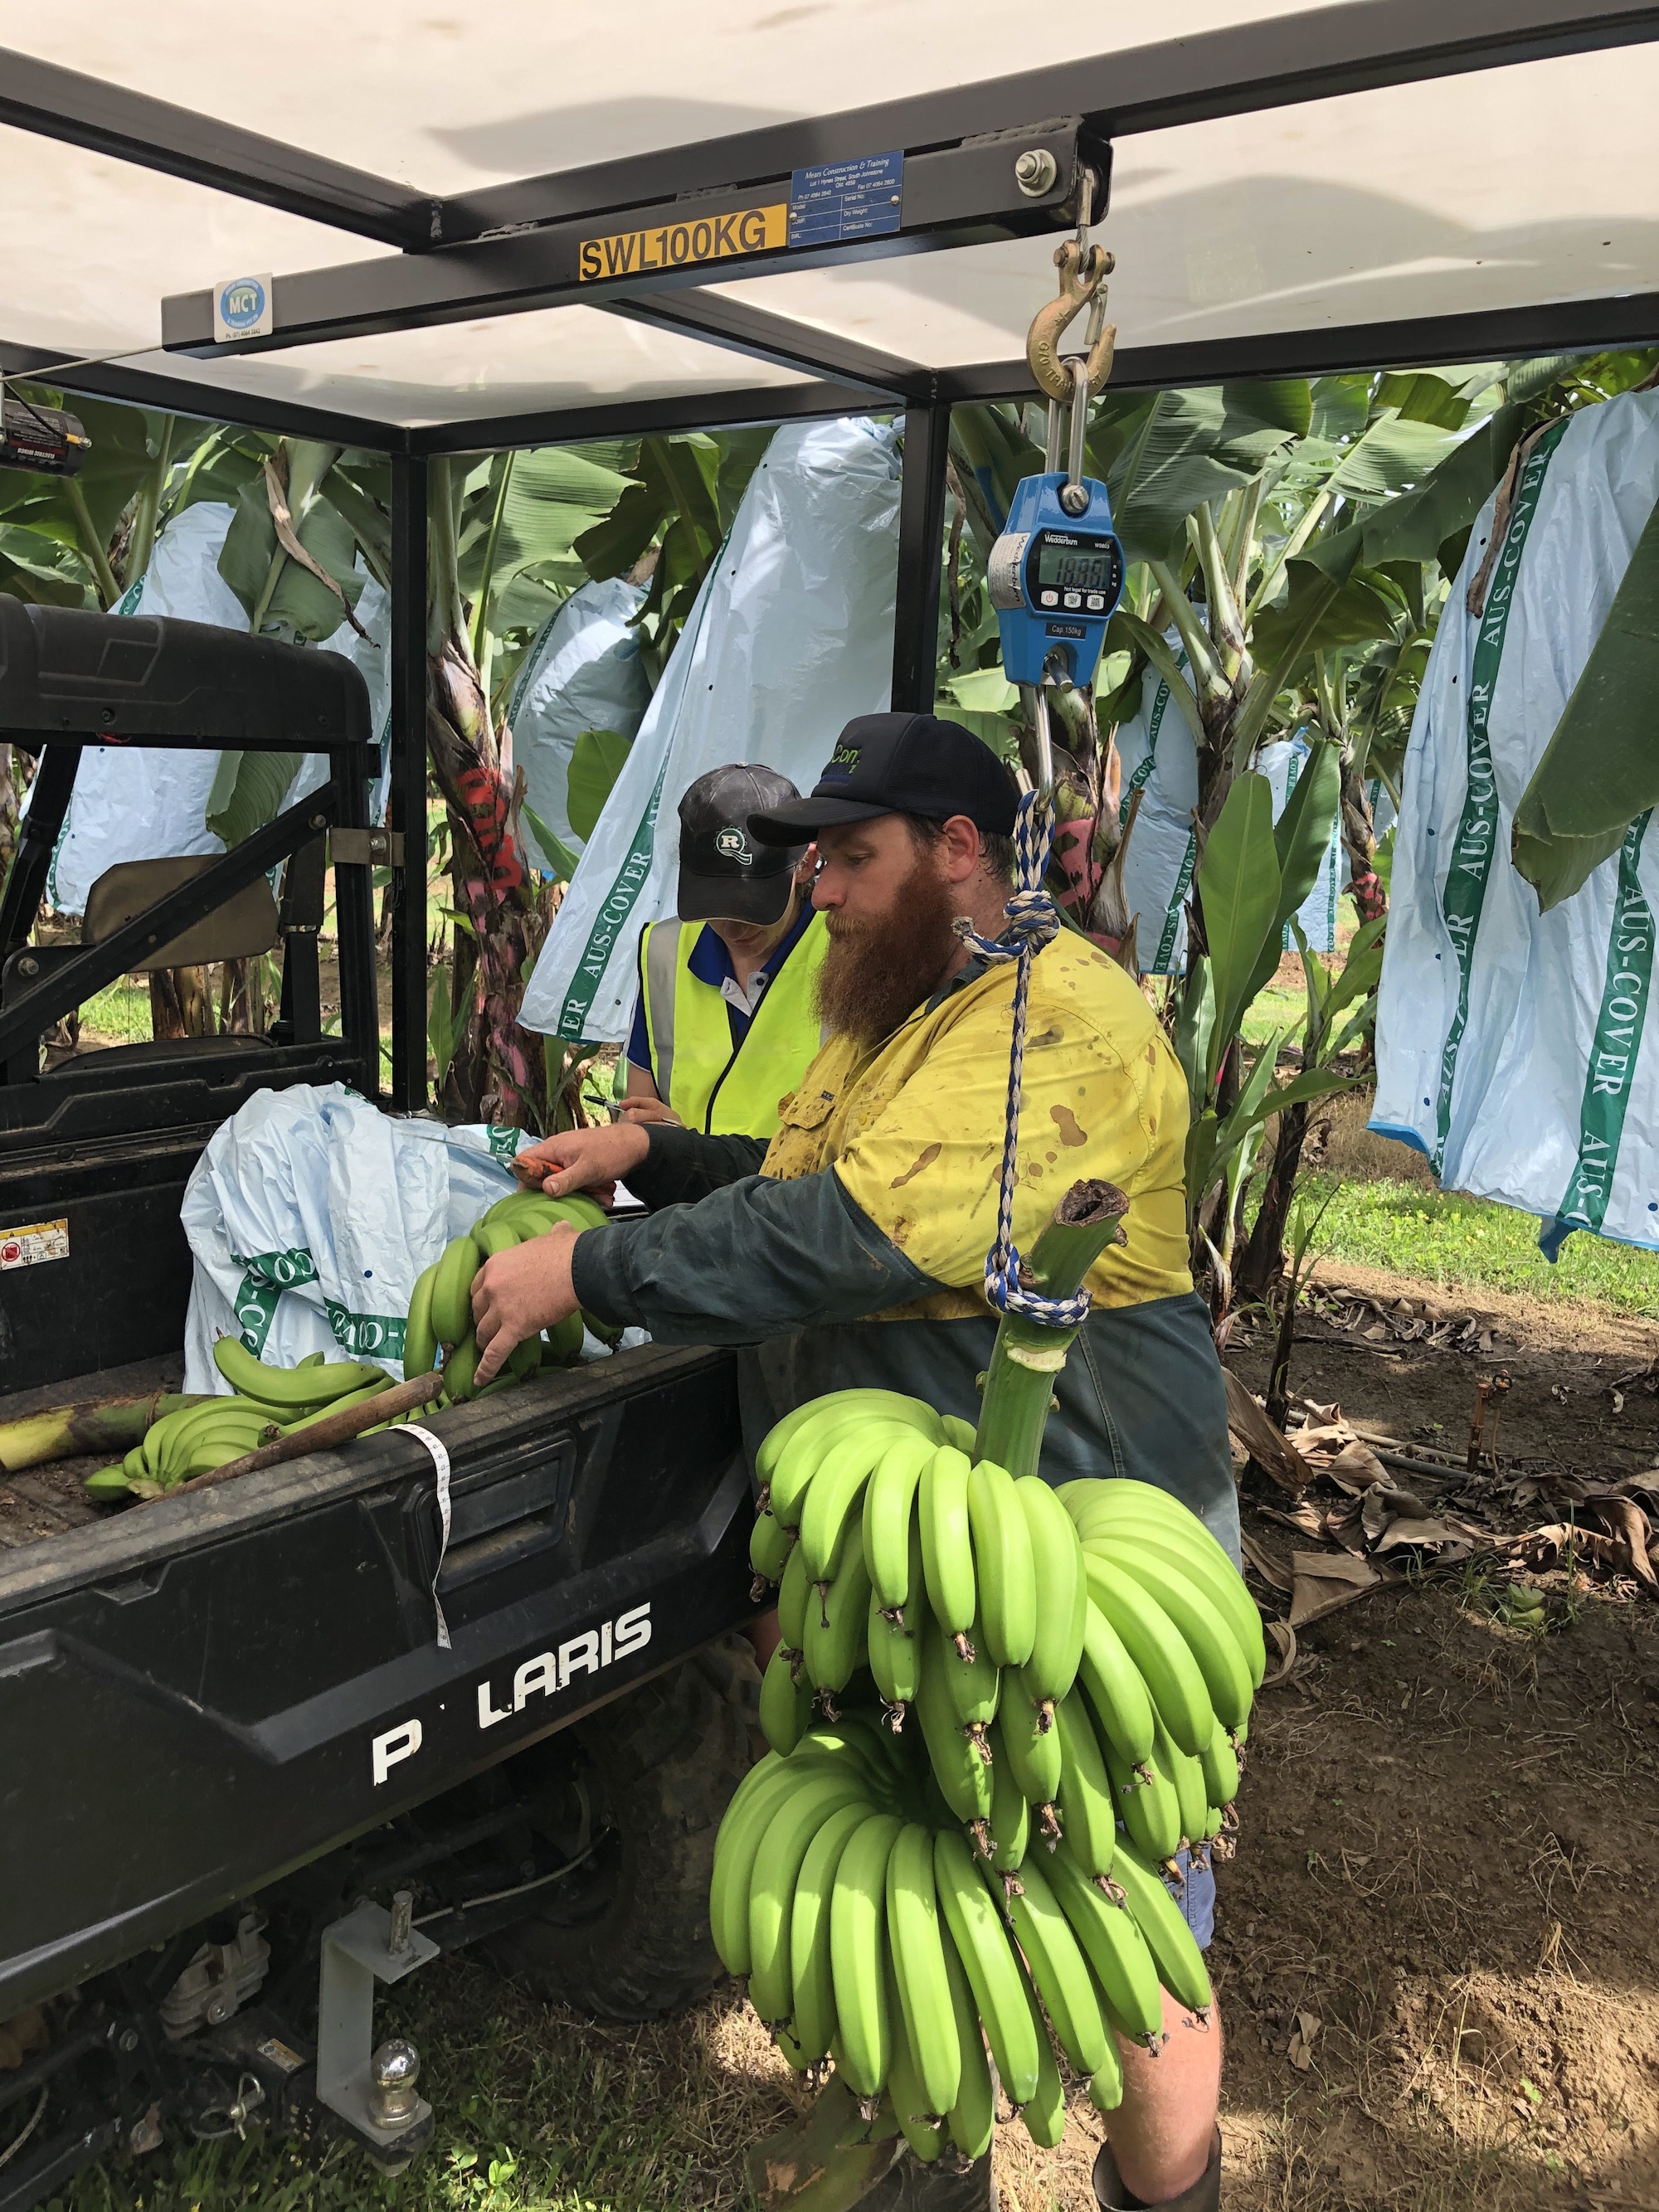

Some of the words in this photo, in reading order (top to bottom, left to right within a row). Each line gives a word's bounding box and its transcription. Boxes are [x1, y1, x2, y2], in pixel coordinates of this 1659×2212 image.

[805, 171, 821, 179] Mears
[823, 164, 858, 177] Construction
[859, 161, 865, 170] &
[867, 158, 890, 168] Training
[844, 194, 857, 202] Serial
[581, 210, 766, 280] SWL100KG
[843, 223, 864, 231] Certificate
[229, 293, 257, 314] MCT
[1044, 533, 1078, 547] Wedderburn
[1482, 445, 1552, 648] AUS-COVER
[1457, 680, 1495, 881] AUS-COVER
[582, 851, 652, 980] AUS-COVER
[1593, 884, 1650, 1095] AUS-COVER
[372, 1602, 652, 1787] PLARIS
